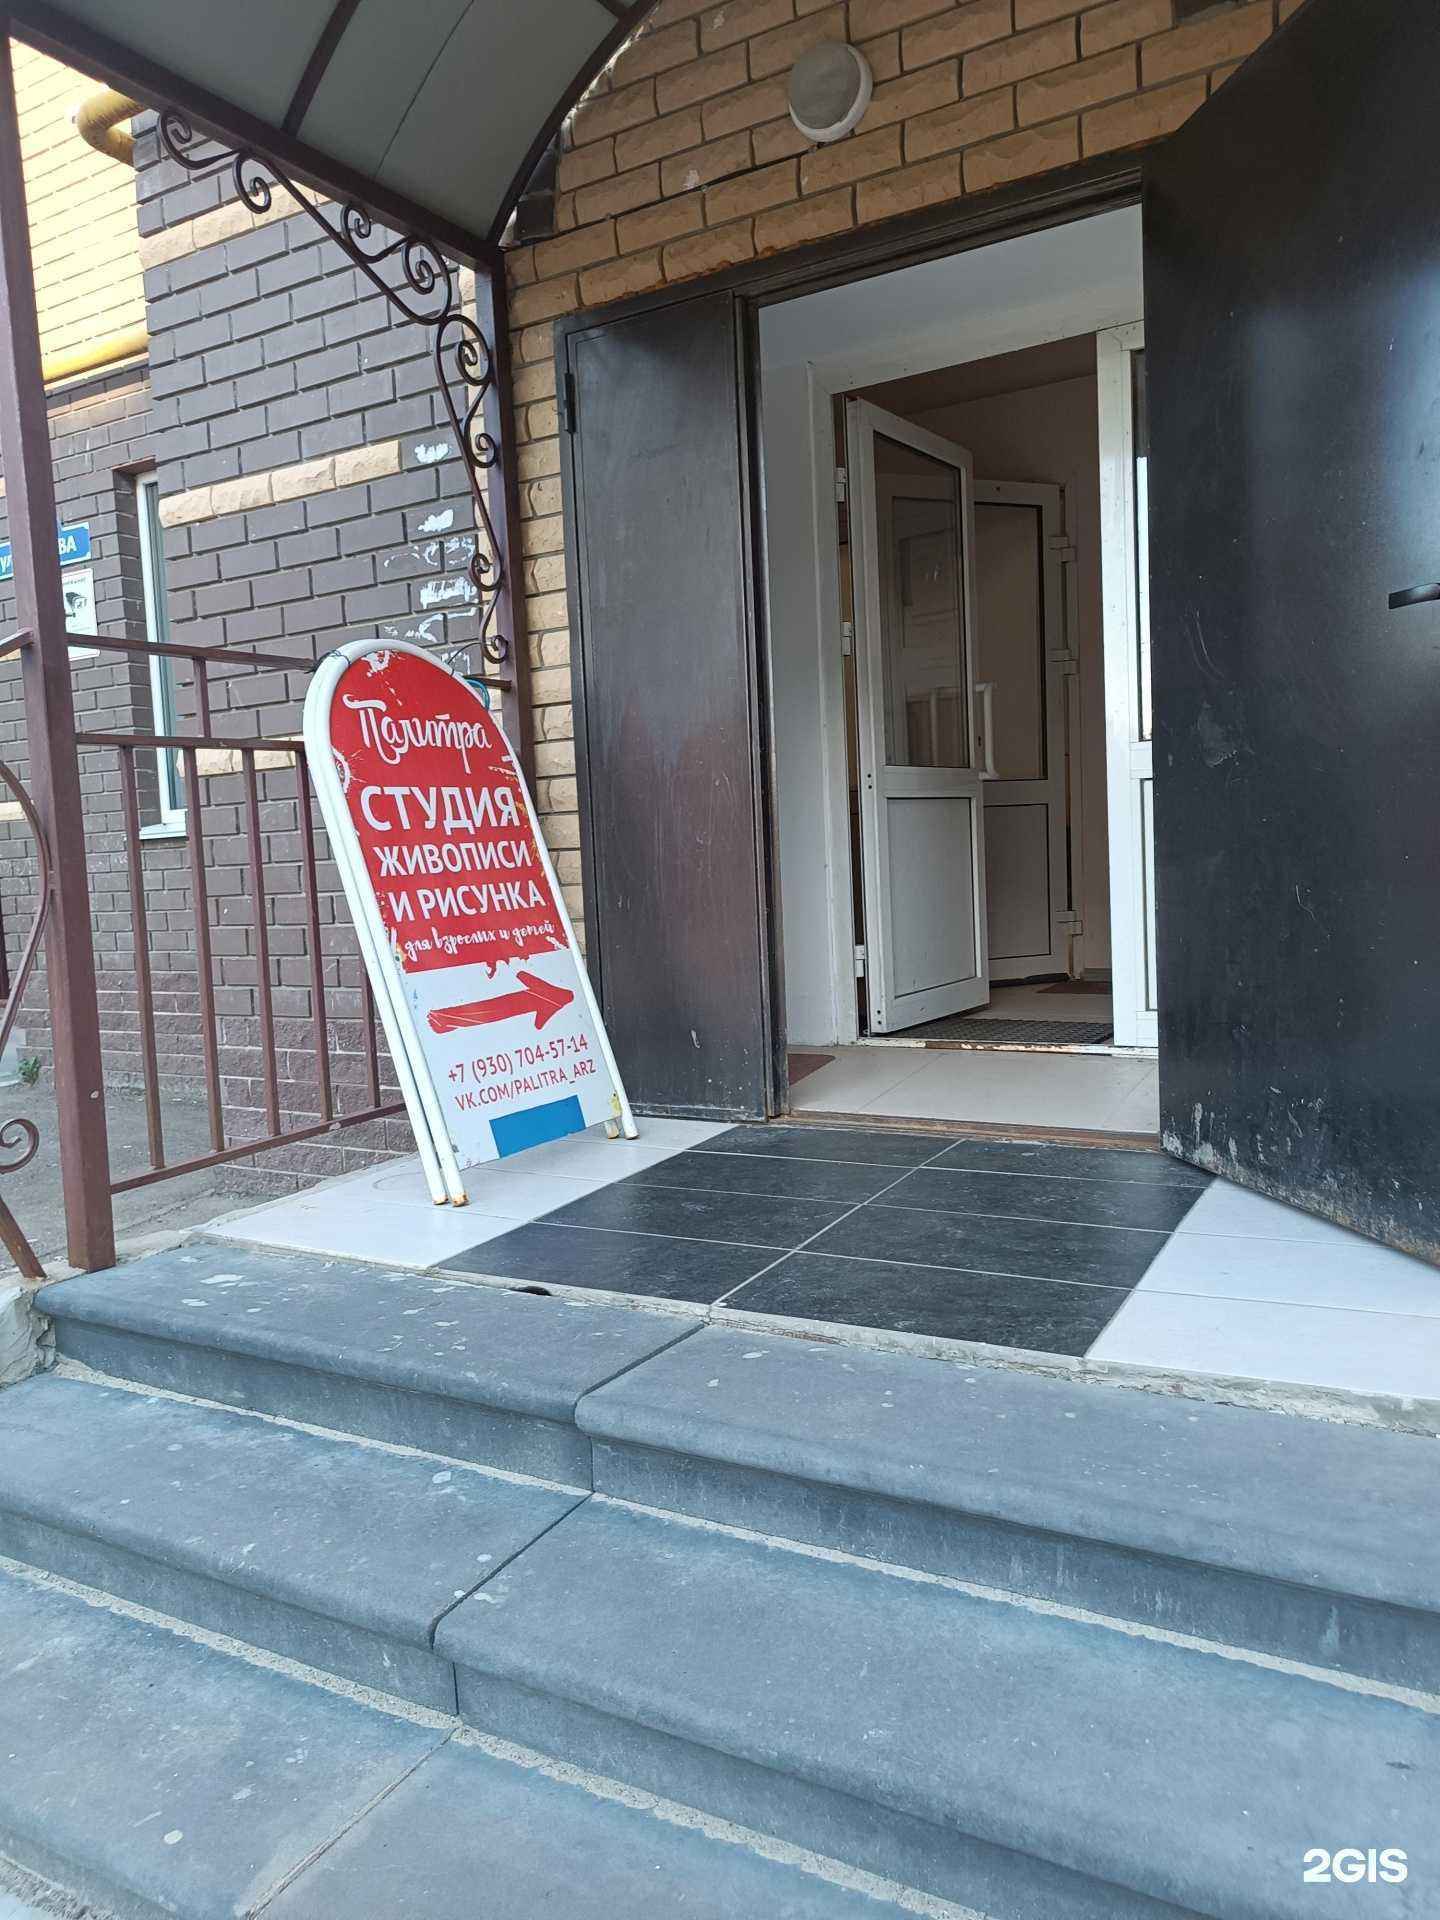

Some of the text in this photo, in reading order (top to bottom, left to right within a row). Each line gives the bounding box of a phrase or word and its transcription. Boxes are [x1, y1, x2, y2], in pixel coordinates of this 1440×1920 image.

[342, 693, 492, 775] Палитра
[360, 786, 520, 835] СТУДИЯ
[372, 841, 532, 877] ЖИВОПИСИ
[387, 880, 546, 922] И РИСУНКА
[404, 919, 555, 962] для взрослых и детей
[448, 1033, 589, 1084] +7 (930) 704-57-14
[454, 1058, 597, 1111] VK.COM/PALITRA_ARZ
